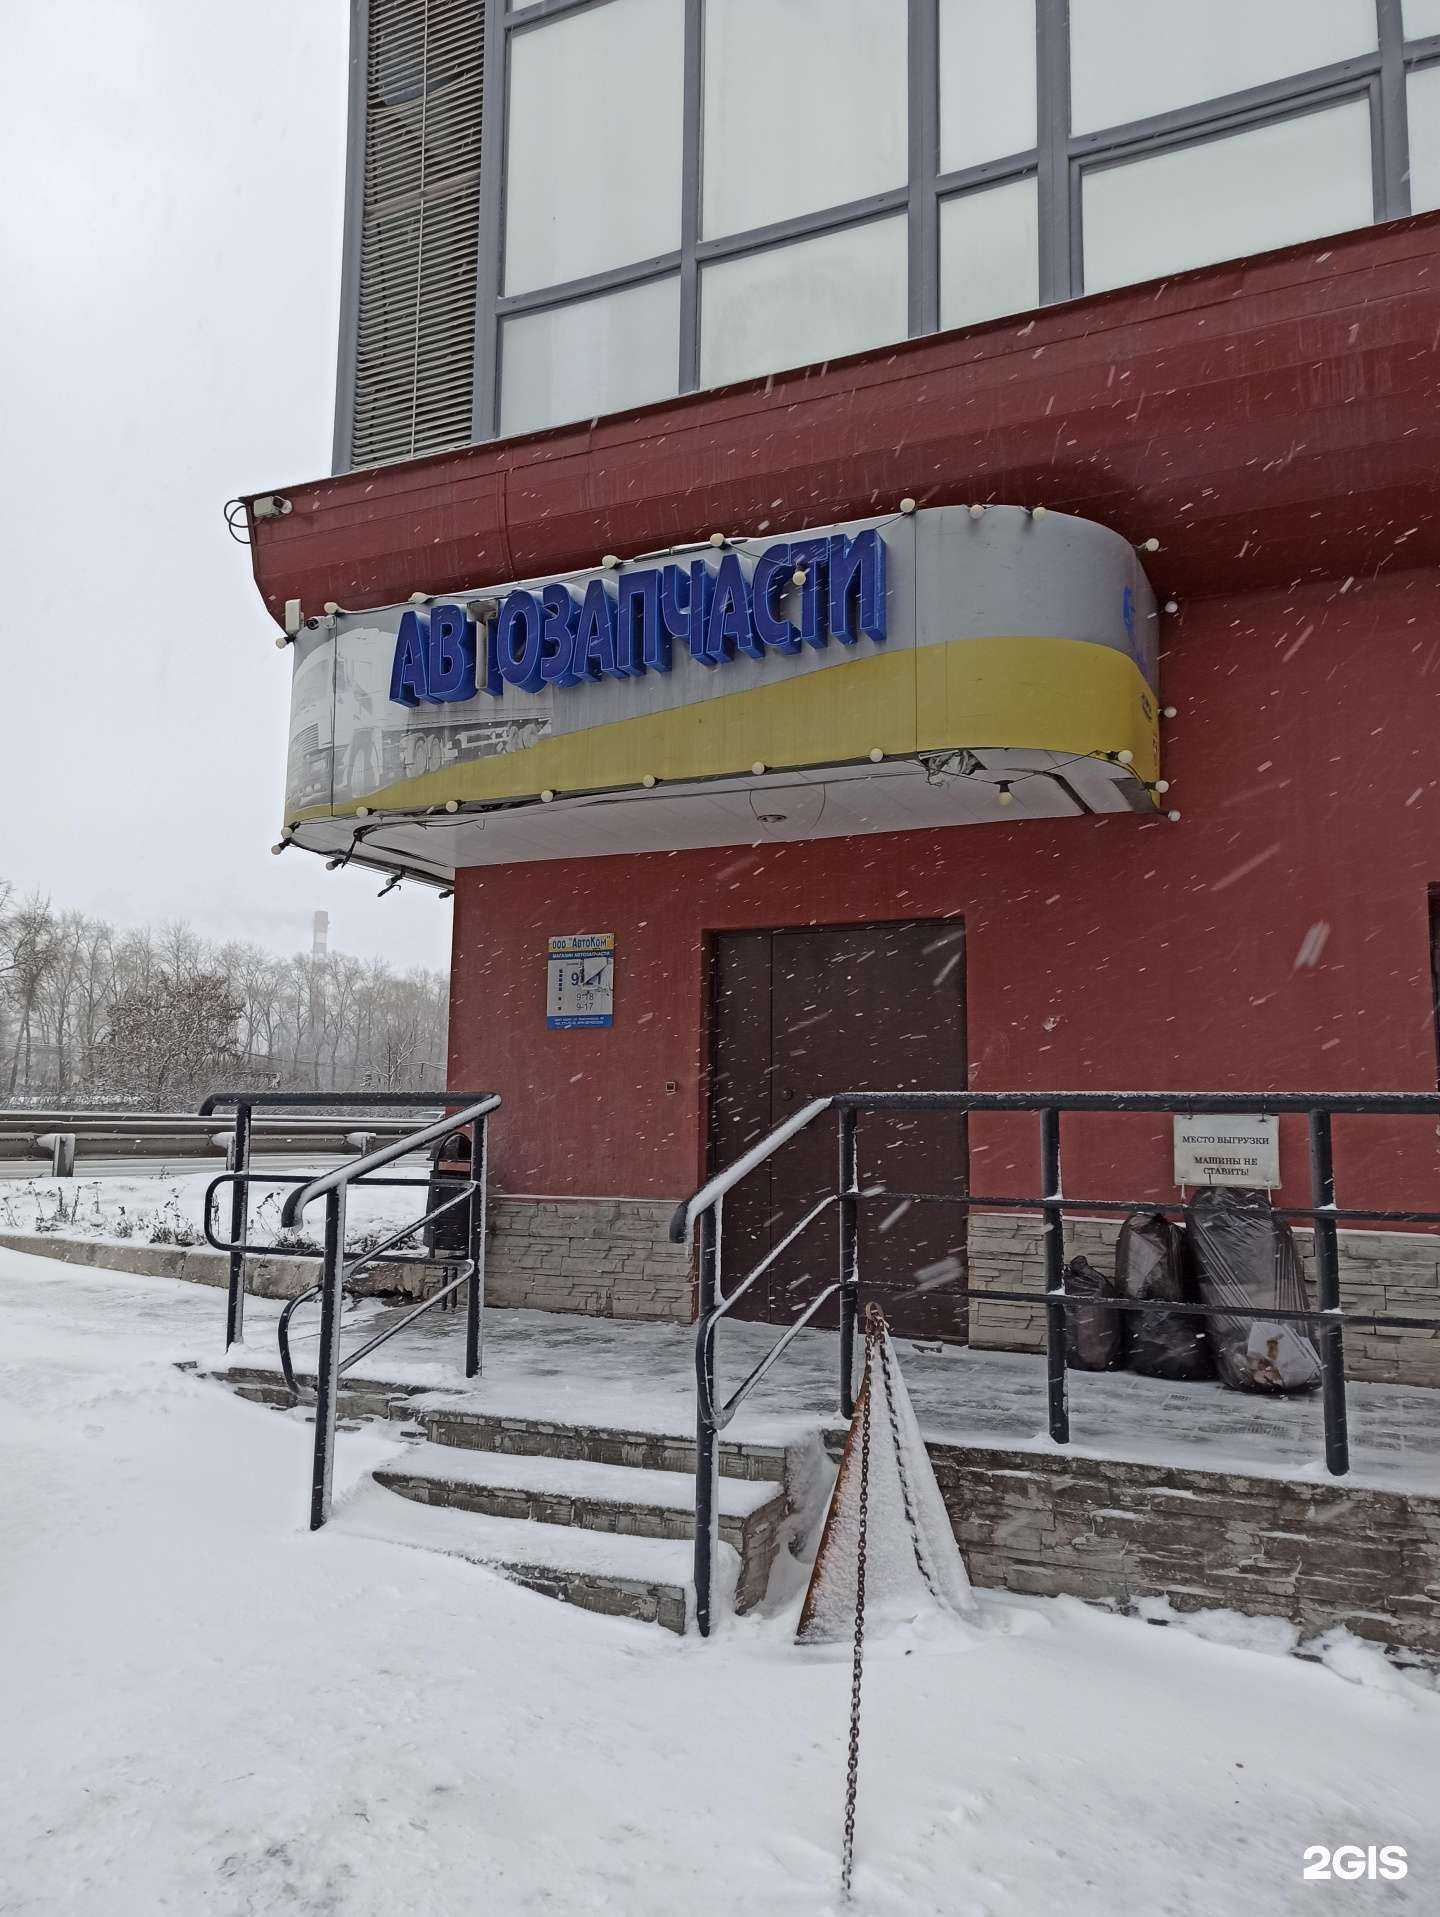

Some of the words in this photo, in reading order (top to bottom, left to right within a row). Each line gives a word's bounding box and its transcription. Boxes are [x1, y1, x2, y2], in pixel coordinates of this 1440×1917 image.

[388, 527, 888, 709] АВТОЗАПЧАСТИ
[552, 940, 566, 949] ООО
[576, 1002, 594, 1011] 9-17
[1182, 1136, 1215, 1144] МЕСТО
[1217, 1136, 1270, 1145] ВЫГРУЗКИ
[1194, 1156, 1241, 1165] МАШИНЫ
[1244, 1158, 1258, 1166] НЕ
[1203, 1167, 1249, 1176] СТАВИТЬ!
